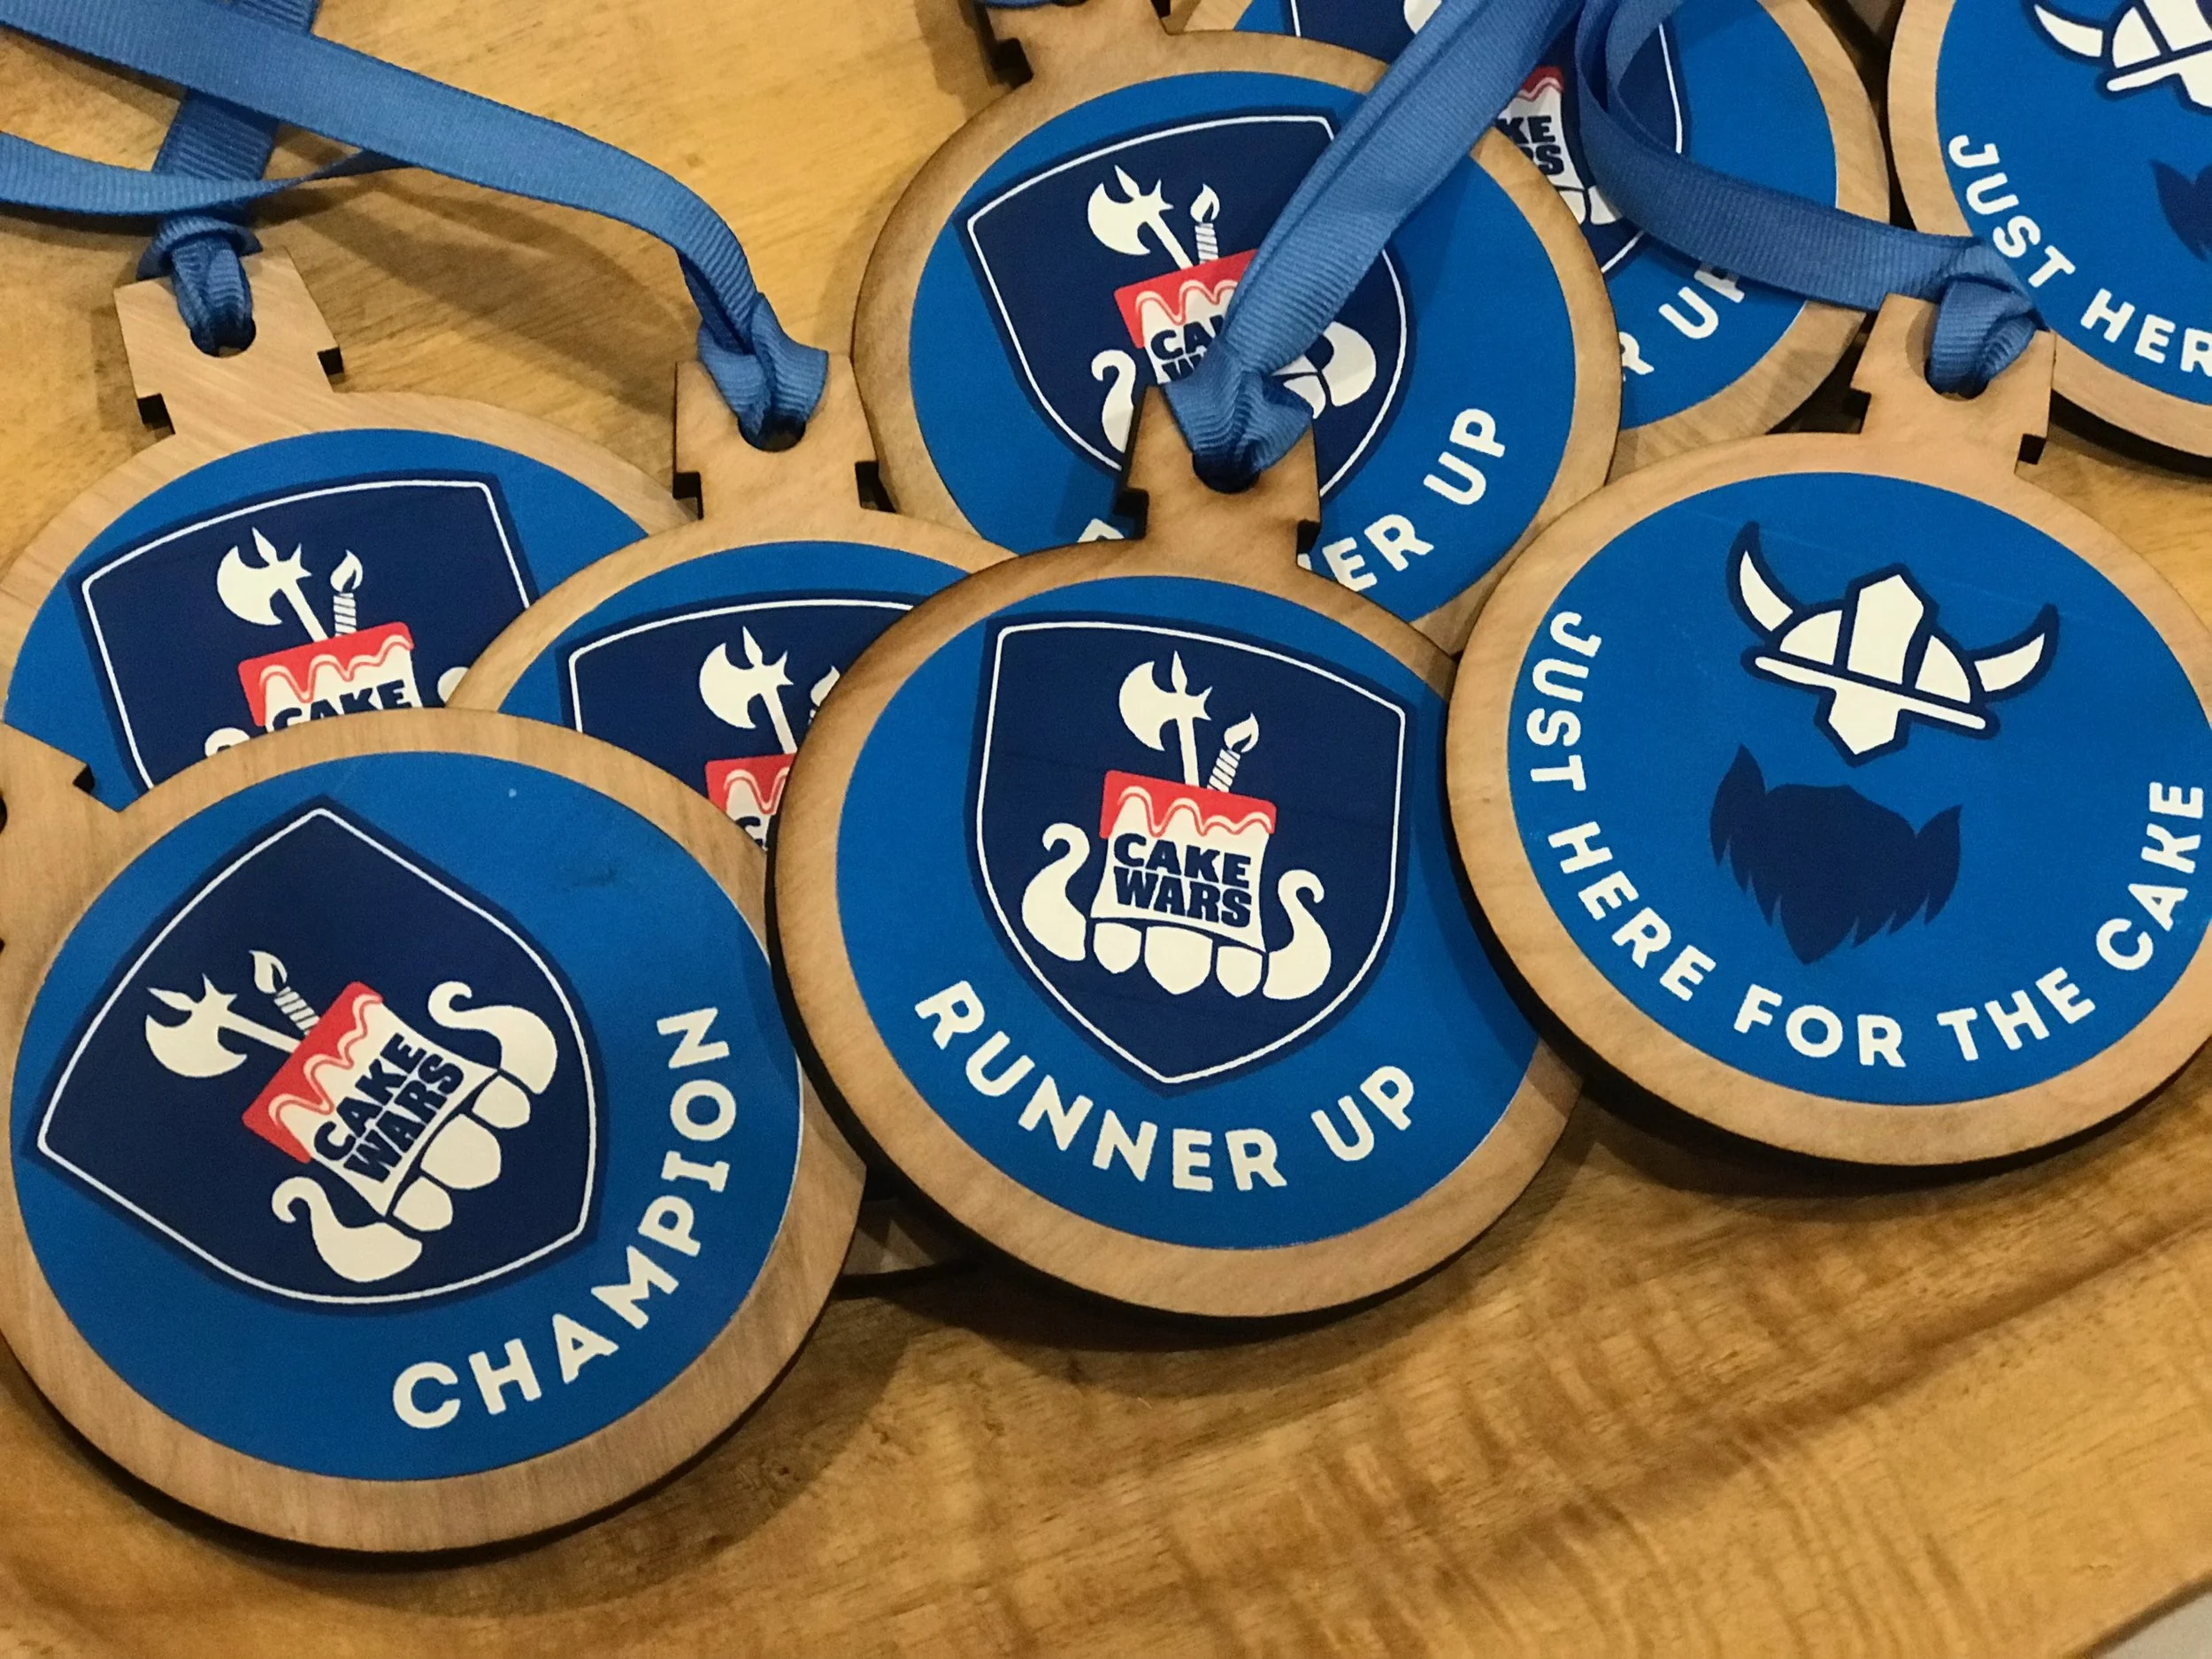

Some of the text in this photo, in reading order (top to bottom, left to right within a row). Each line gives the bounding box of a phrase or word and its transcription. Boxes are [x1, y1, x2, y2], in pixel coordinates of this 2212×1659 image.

[1948, 134, 2076, 288] JUST
[1424, 408, 1506, 505] UP
[1113, 833, 1252, 889] CAKE
[1113, 865, 1253, 928] WARS
[1526, 611, 2204, 1069] JUST HERE FOR THE CAKE
[313, 1033, 427, 1162] CAKE
[342, 1053, 465, 1183] WARS
[915, 980, 1415, 1192] RUNNER UP
[393, 1007, 737, 1430] CHAMPION
